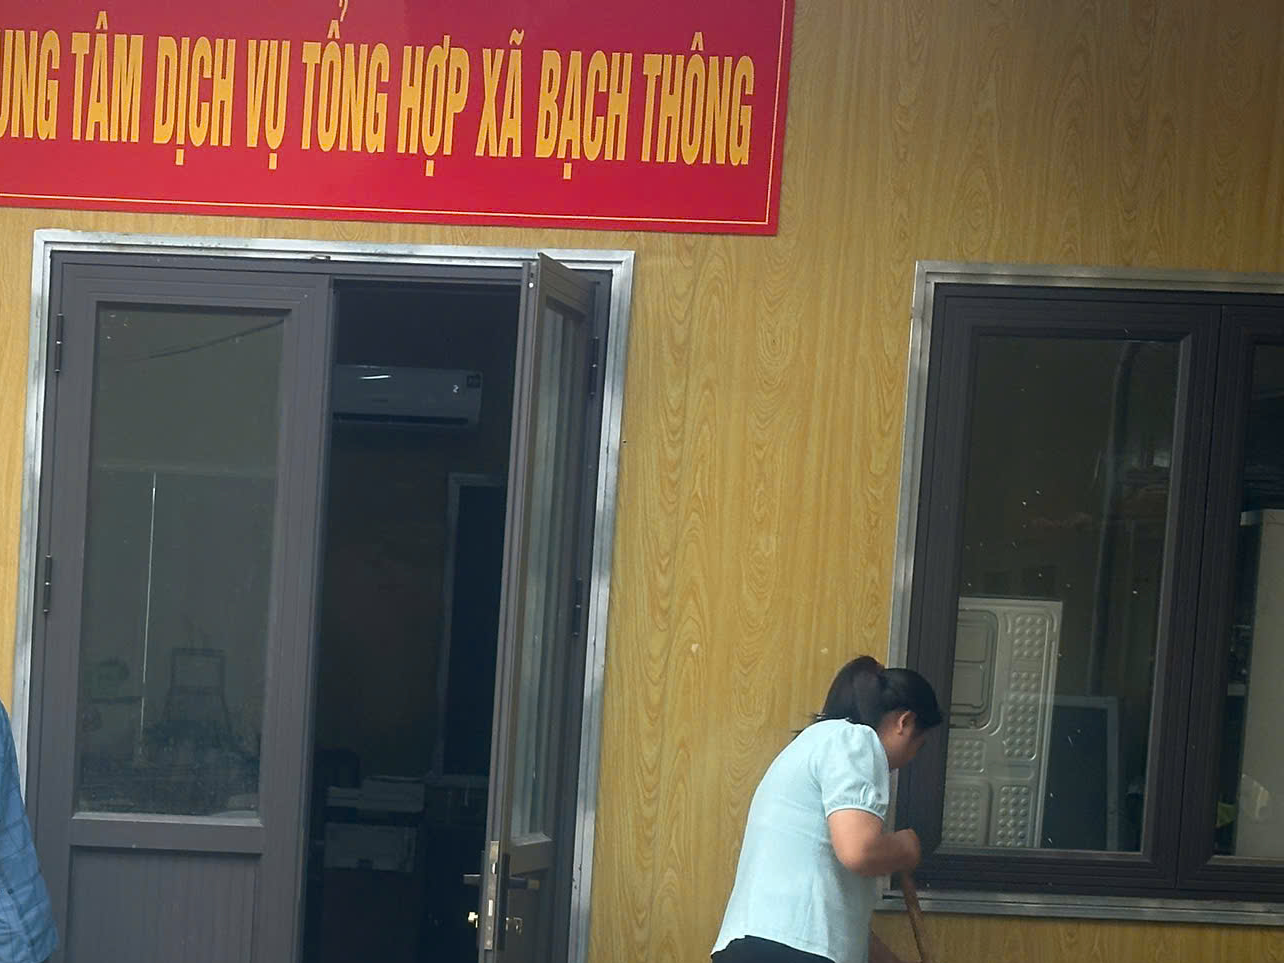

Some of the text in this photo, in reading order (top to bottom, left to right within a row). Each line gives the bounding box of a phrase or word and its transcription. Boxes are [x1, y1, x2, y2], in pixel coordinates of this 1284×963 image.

[71, 11, 144, 143] TÂM
[152, 35, 236, 166] DỊCH
[246, 39, 291, 169] VỤ
[301, 0, 390, 154] TỔNG
[397, 34, 470, 177] HỢP
[475, 28, 525, 158] XÃ
[534, 50, 633, 180] BẠCH
[641, 31, 755, 167] THÔNG
